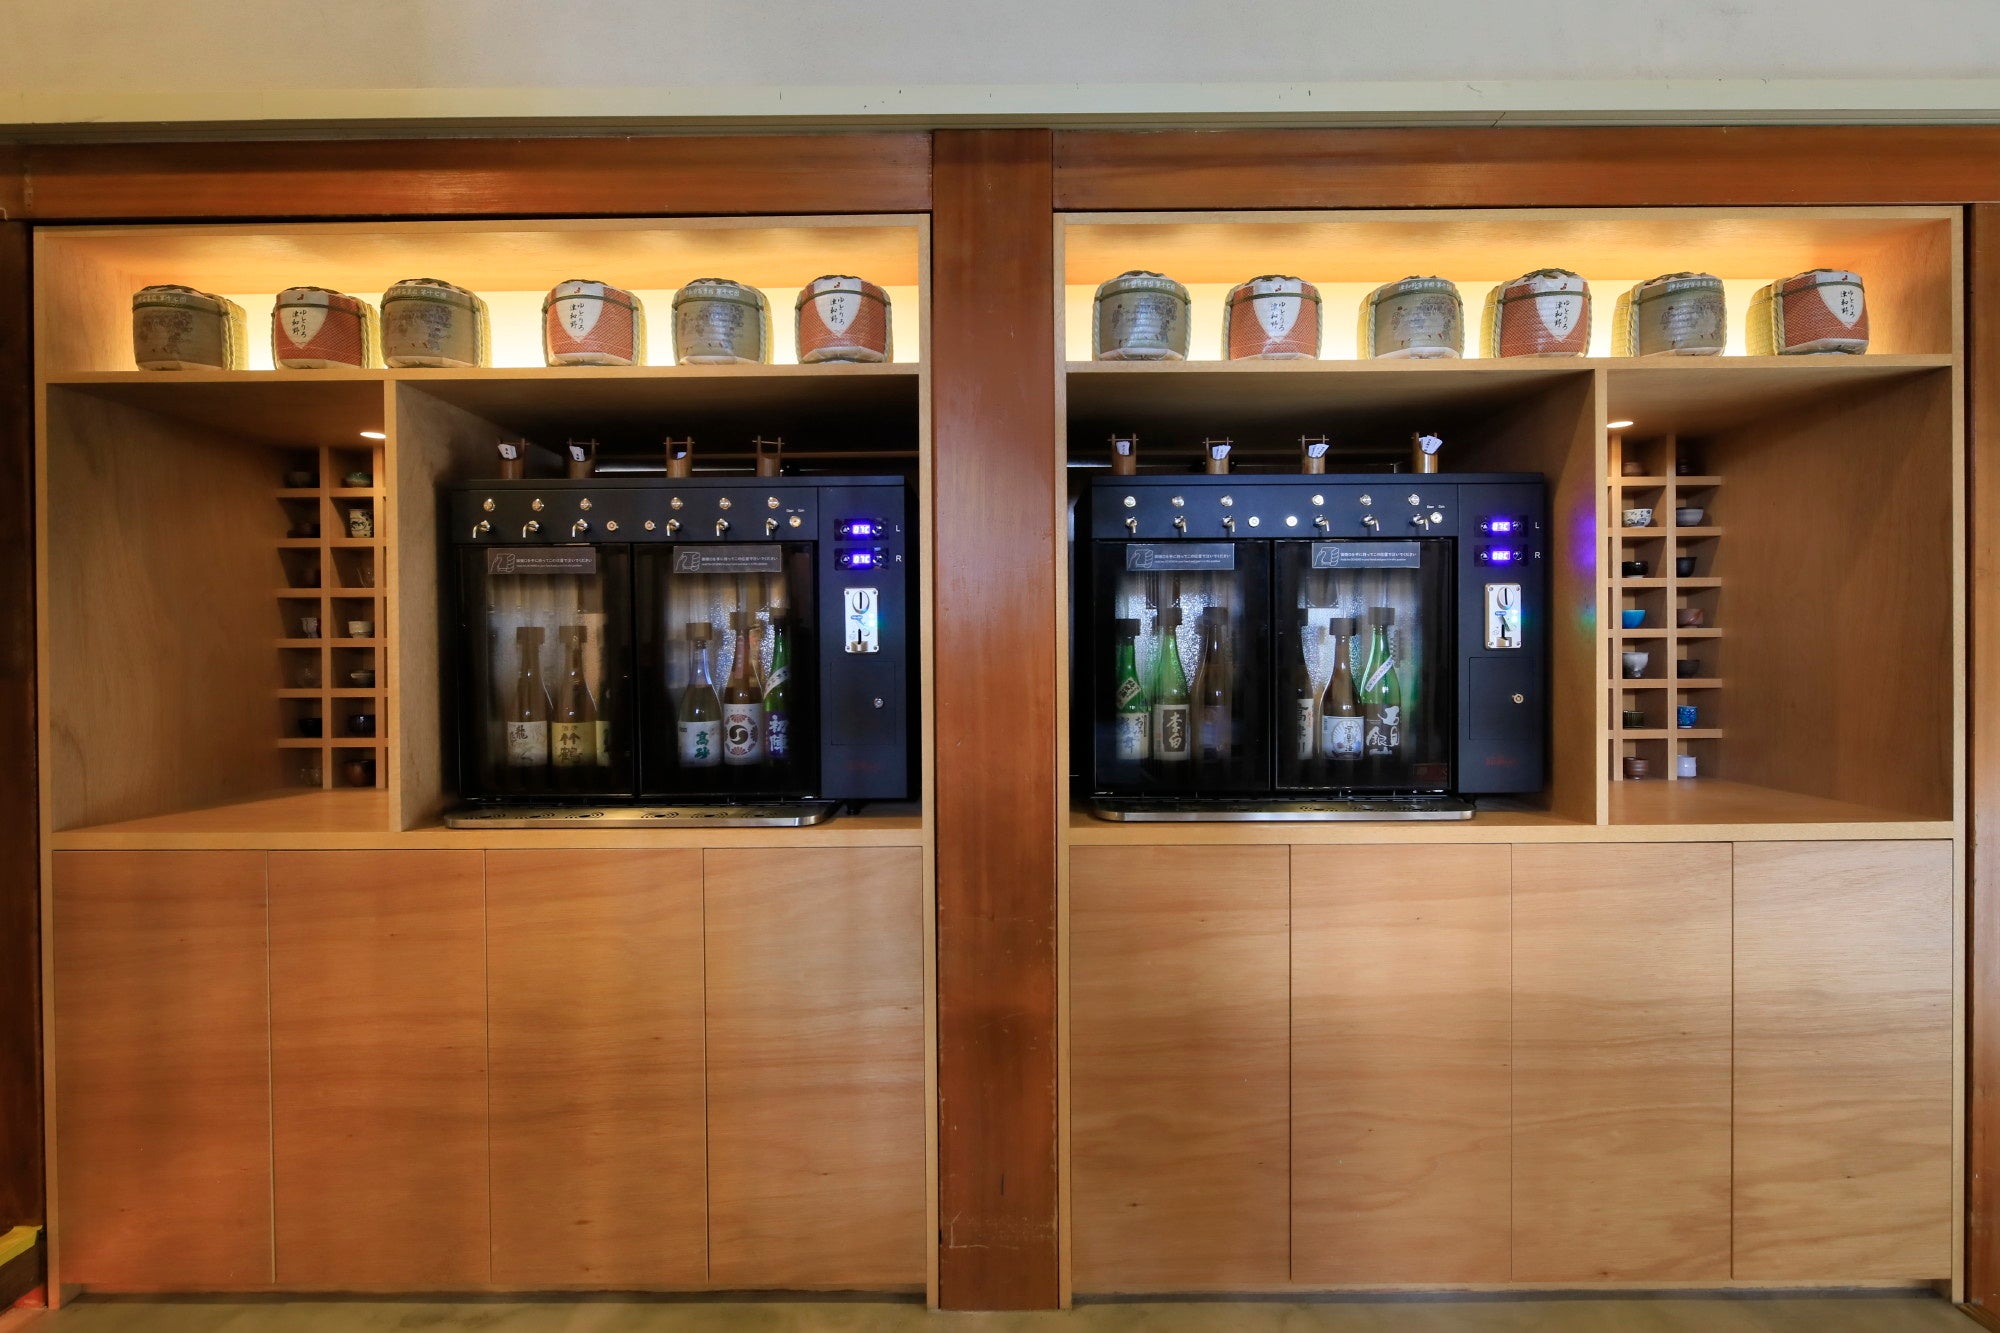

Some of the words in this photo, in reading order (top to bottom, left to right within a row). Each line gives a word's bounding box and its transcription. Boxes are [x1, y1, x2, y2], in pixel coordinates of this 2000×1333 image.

[896, 524, 901, 532] L
[1534, 551, 1541, 559] R
[769, 714, 788, 755] 初陣
[1166, 711, 1182, 749] 李白
[695, 731, 710, 759] 高砂
